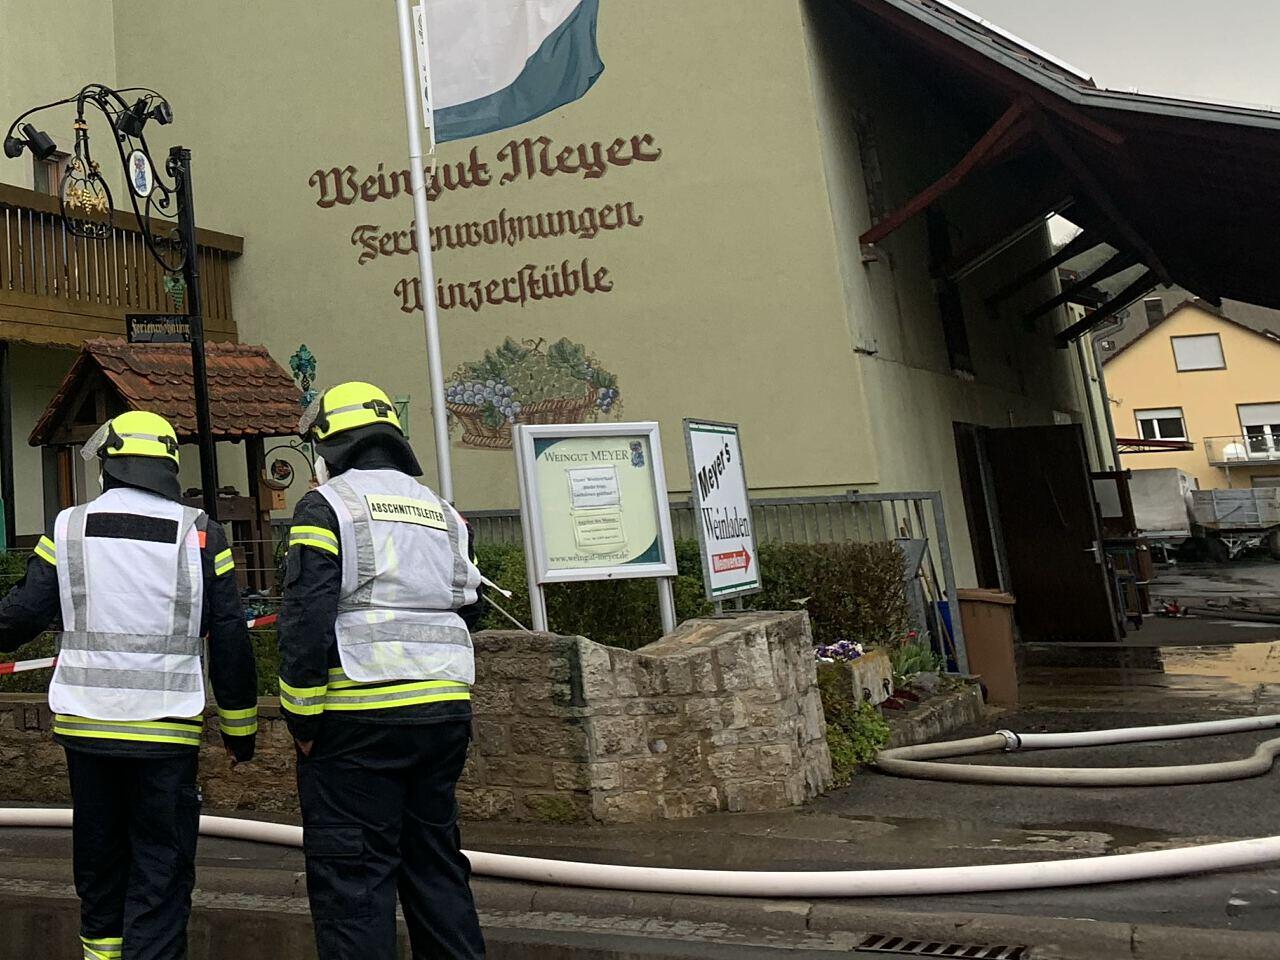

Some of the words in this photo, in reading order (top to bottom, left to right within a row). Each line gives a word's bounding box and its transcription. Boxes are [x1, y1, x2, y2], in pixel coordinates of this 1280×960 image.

[497, 133, 662, 186] Meyer
[591, 449, 629, 461] MEYER
[697, 435, 731, 502] Meyer's
[371, 502, 445, 523] ABSCHNITTSLEITER
[702, 506, 751, 541] Weinladen
